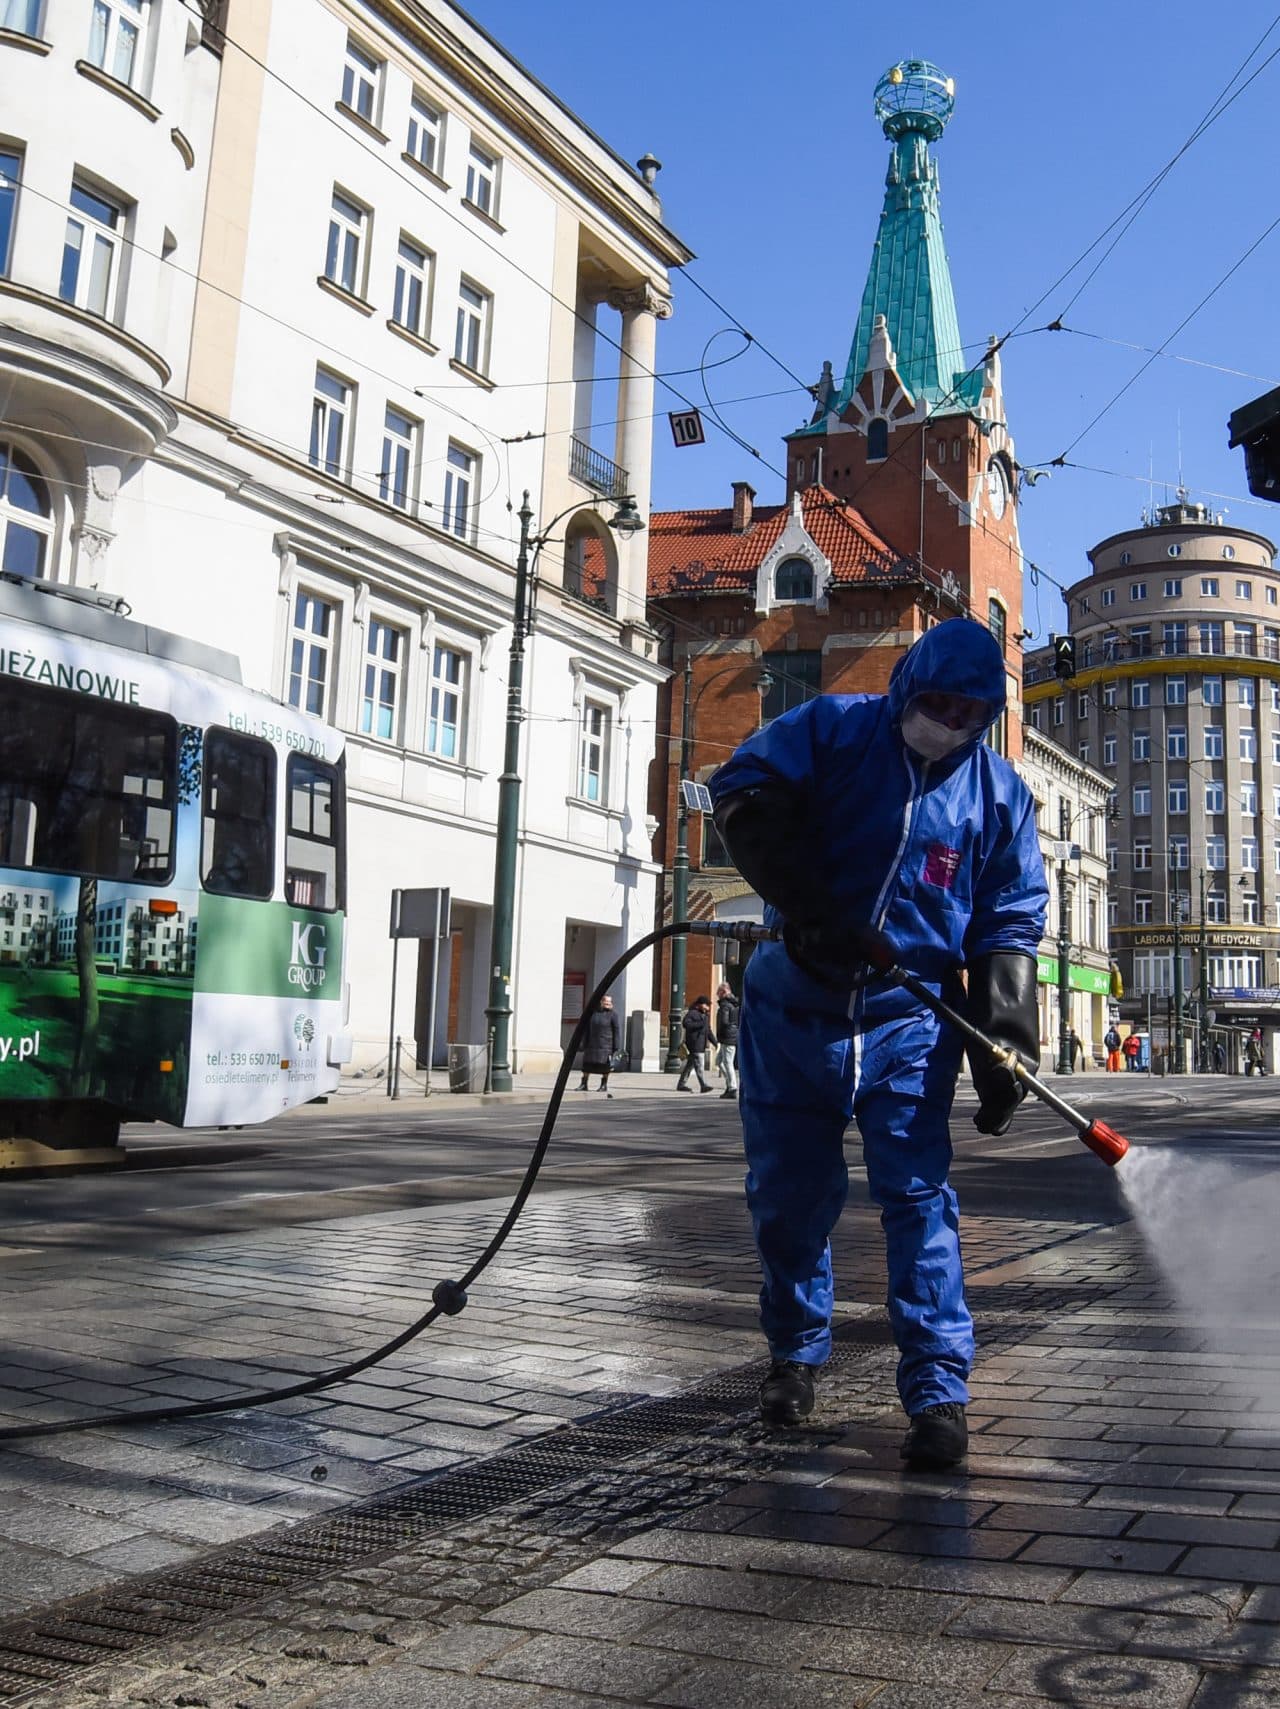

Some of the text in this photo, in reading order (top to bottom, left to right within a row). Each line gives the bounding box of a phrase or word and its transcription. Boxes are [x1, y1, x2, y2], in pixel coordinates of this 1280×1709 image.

[675, 418, 698, 441] 10
[261, 721, 283, 742] 539
[285, 730, 306, 751] 650
[308, 738, 326, 760] 701
[290, 921, 327, 966] KG
[1135, 934, 1262, 945] LABORATORIU MEDYCZNE
[288, 966, 326, 992] GROUP
[207, 1050, 280, 1066] tel.: 539 650 701
